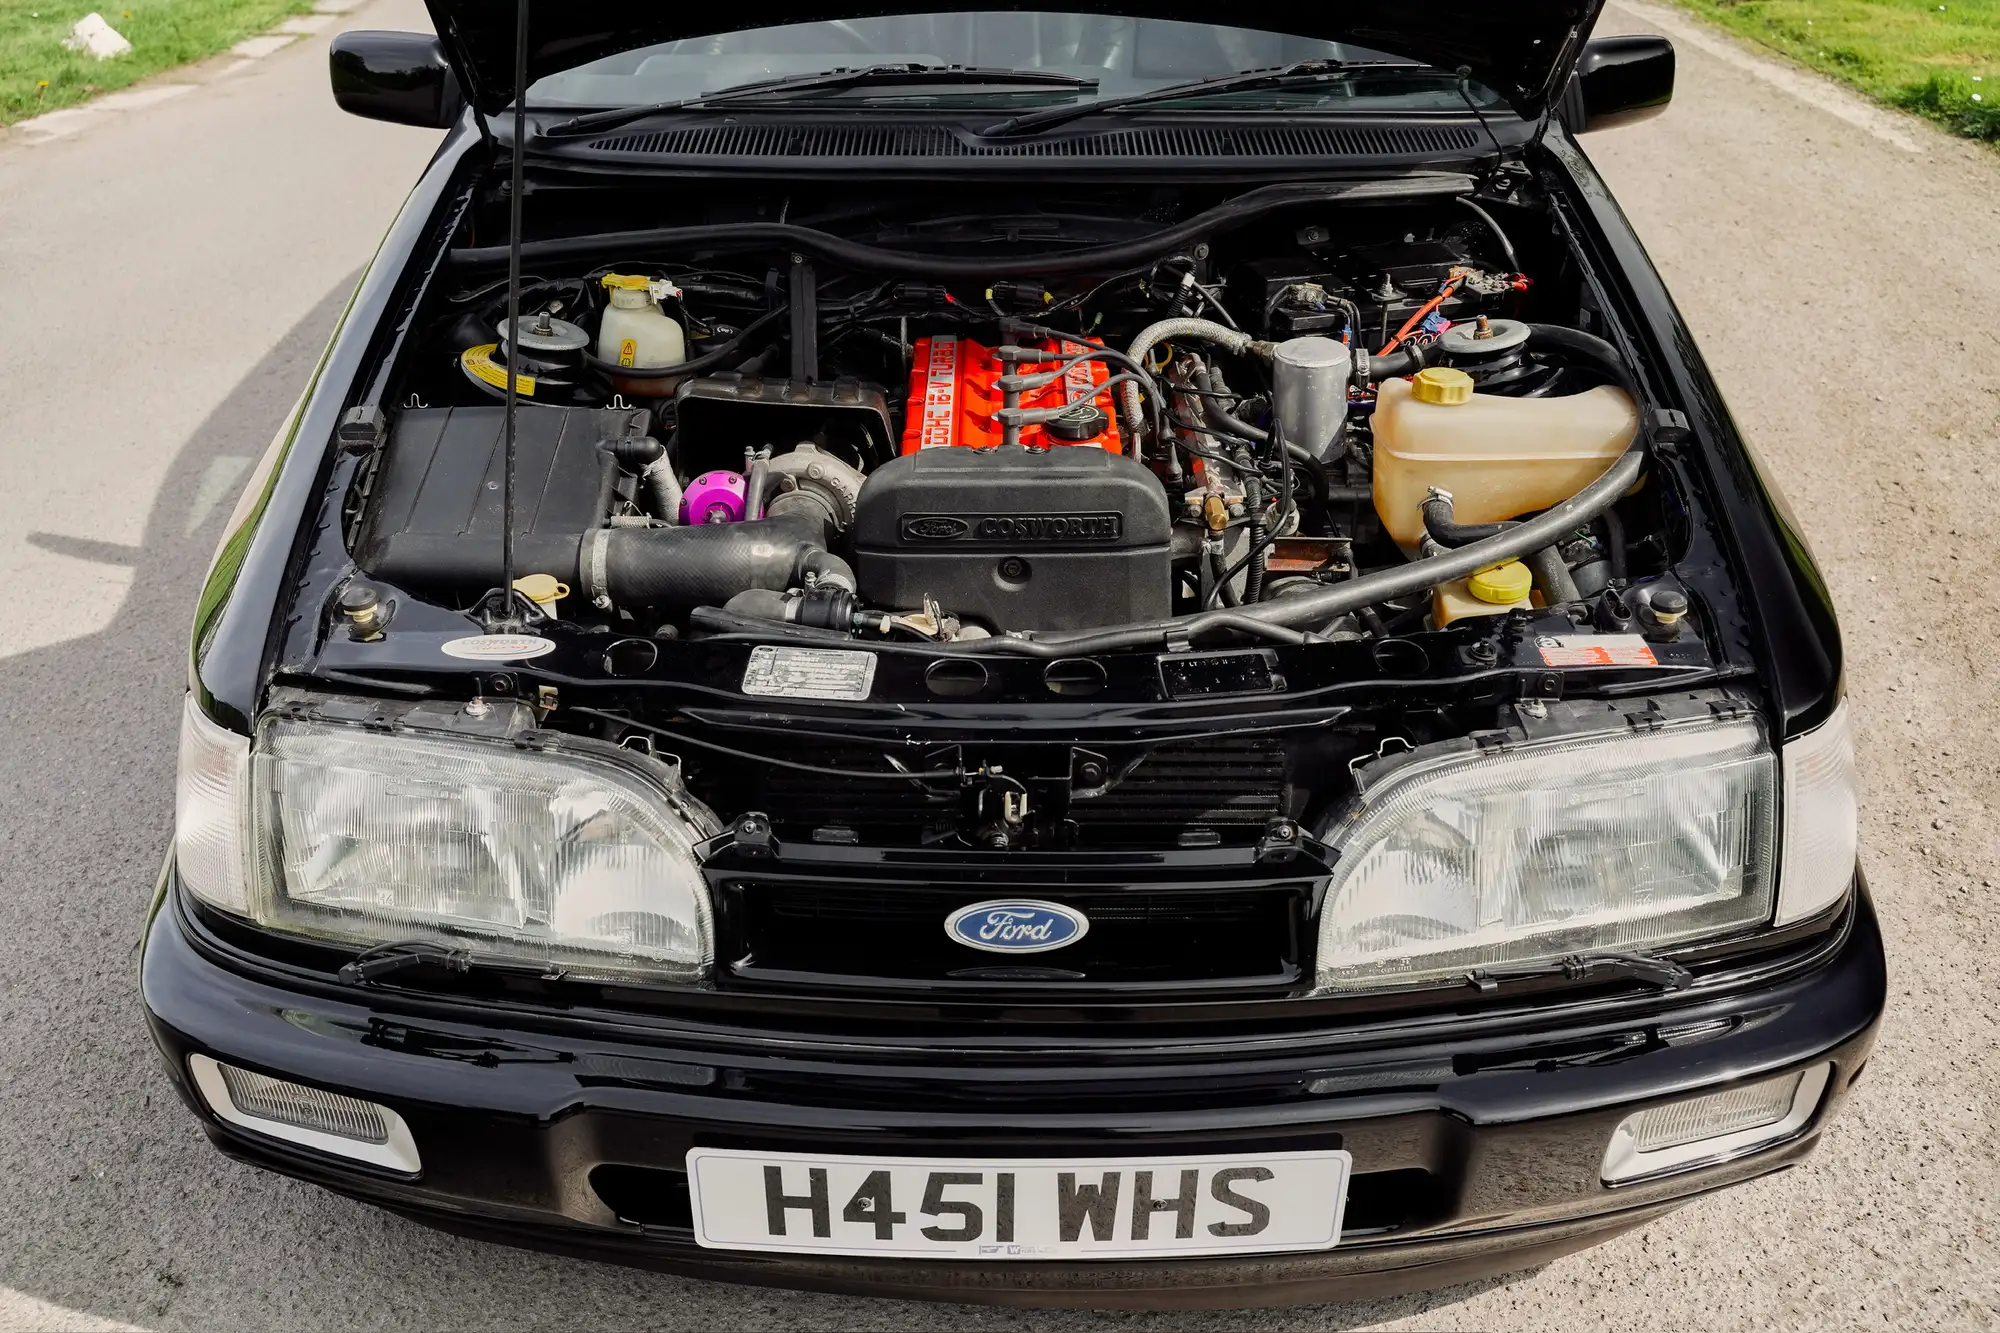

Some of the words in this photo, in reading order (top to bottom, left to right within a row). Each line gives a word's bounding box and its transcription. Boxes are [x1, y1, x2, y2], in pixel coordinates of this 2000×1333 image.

[930, 341, 955, 377] TURBO
[919, 519, 958, 537] Ford
[980, 516, 1118, 539] COSWORTH
[979, 911, 1054, 940] Ford
[763, 1165, 1016, 1242] H451
[1057, 1166, 1275, 1242] WHS
